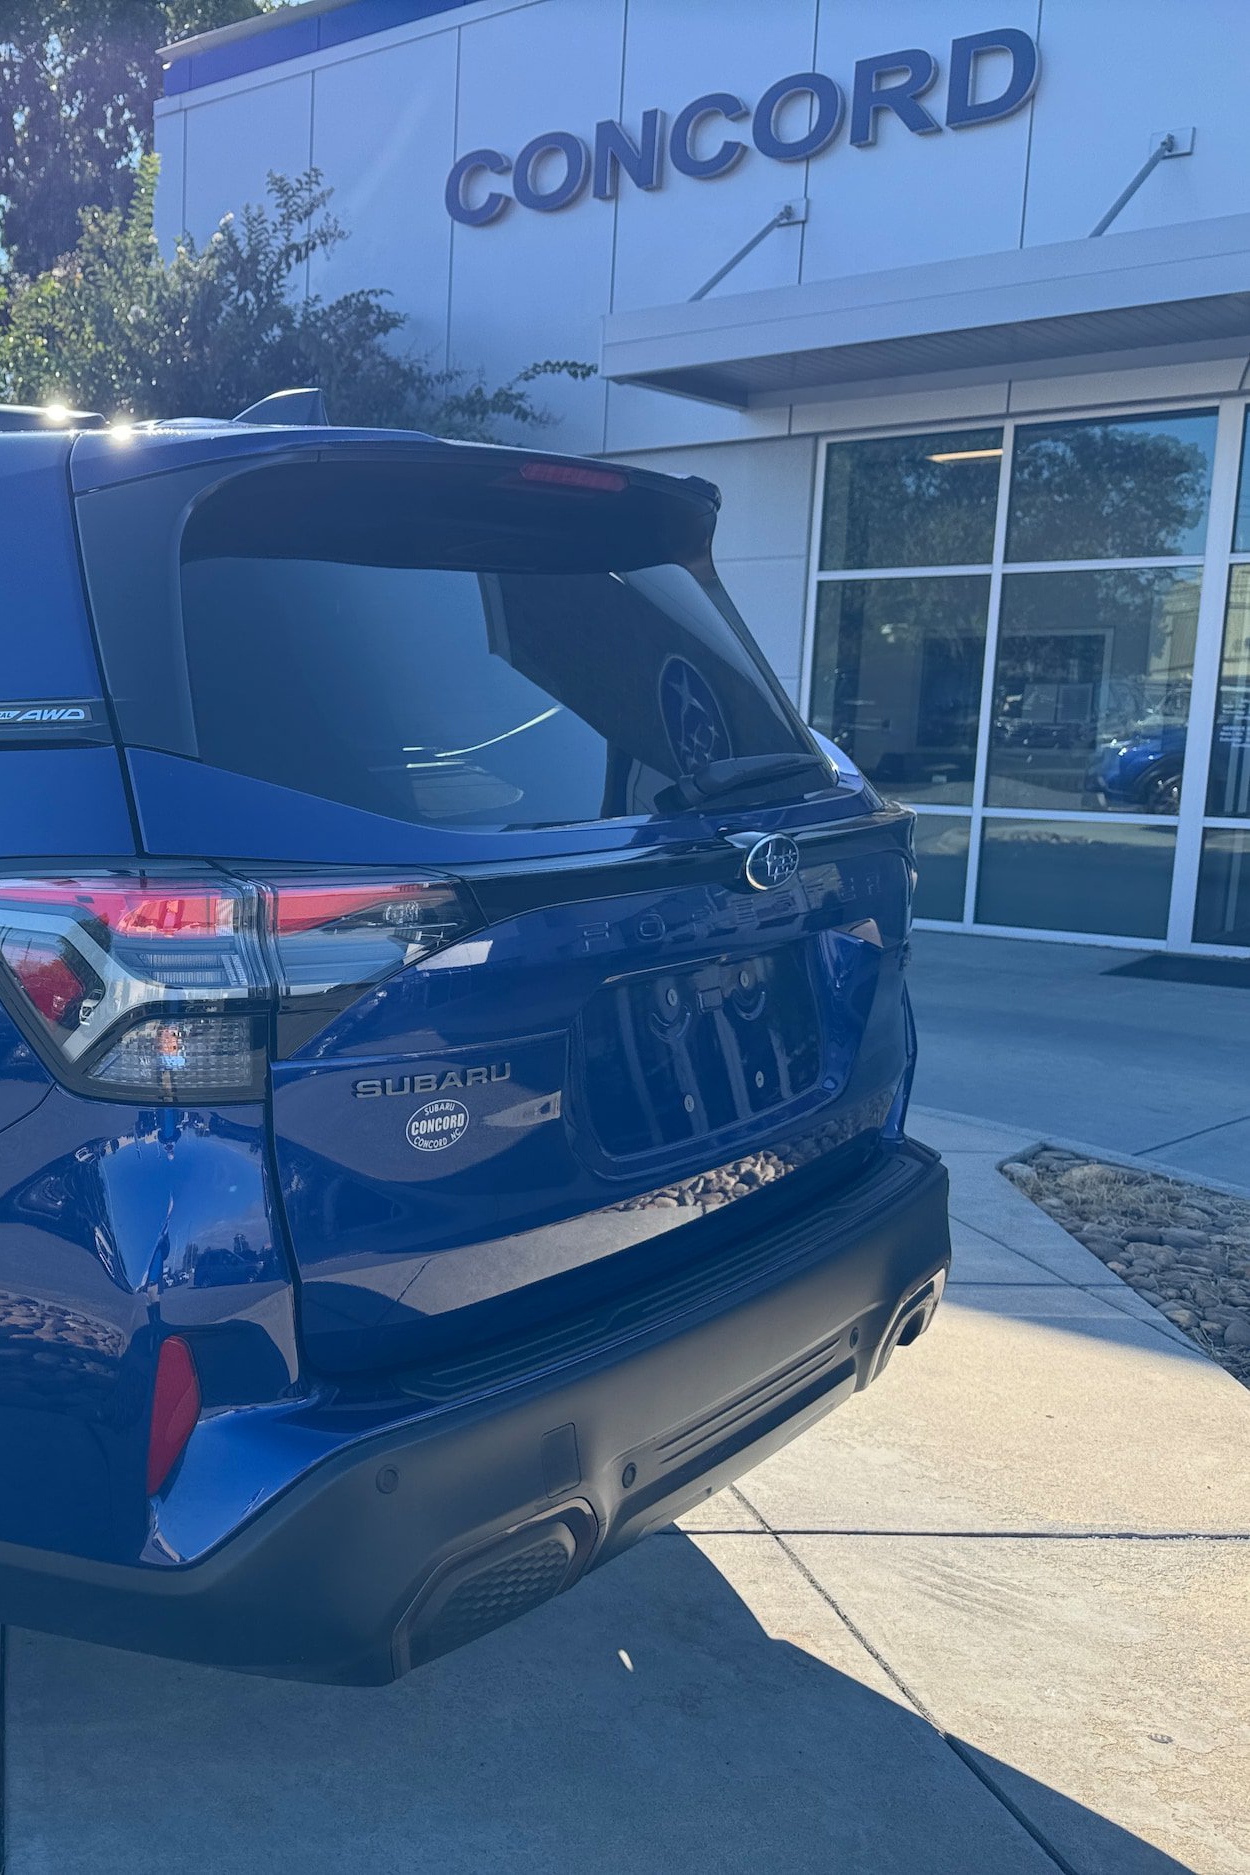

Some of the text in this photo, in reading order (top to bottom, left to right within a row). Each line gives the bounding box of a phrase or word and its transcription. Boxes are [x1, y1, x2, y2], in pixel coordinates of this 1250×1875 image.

[444, 27, 1041, 227] CONCORD
[16, 708, 85, 722] AWD
[354, 1062, 511, 1099] SUBARU
[423, 1102, 456, 1116] SUBARU
[411, 1112, 465, 1136] CONCORD
[413, 1128, 461, 1149] CONCORD NC
